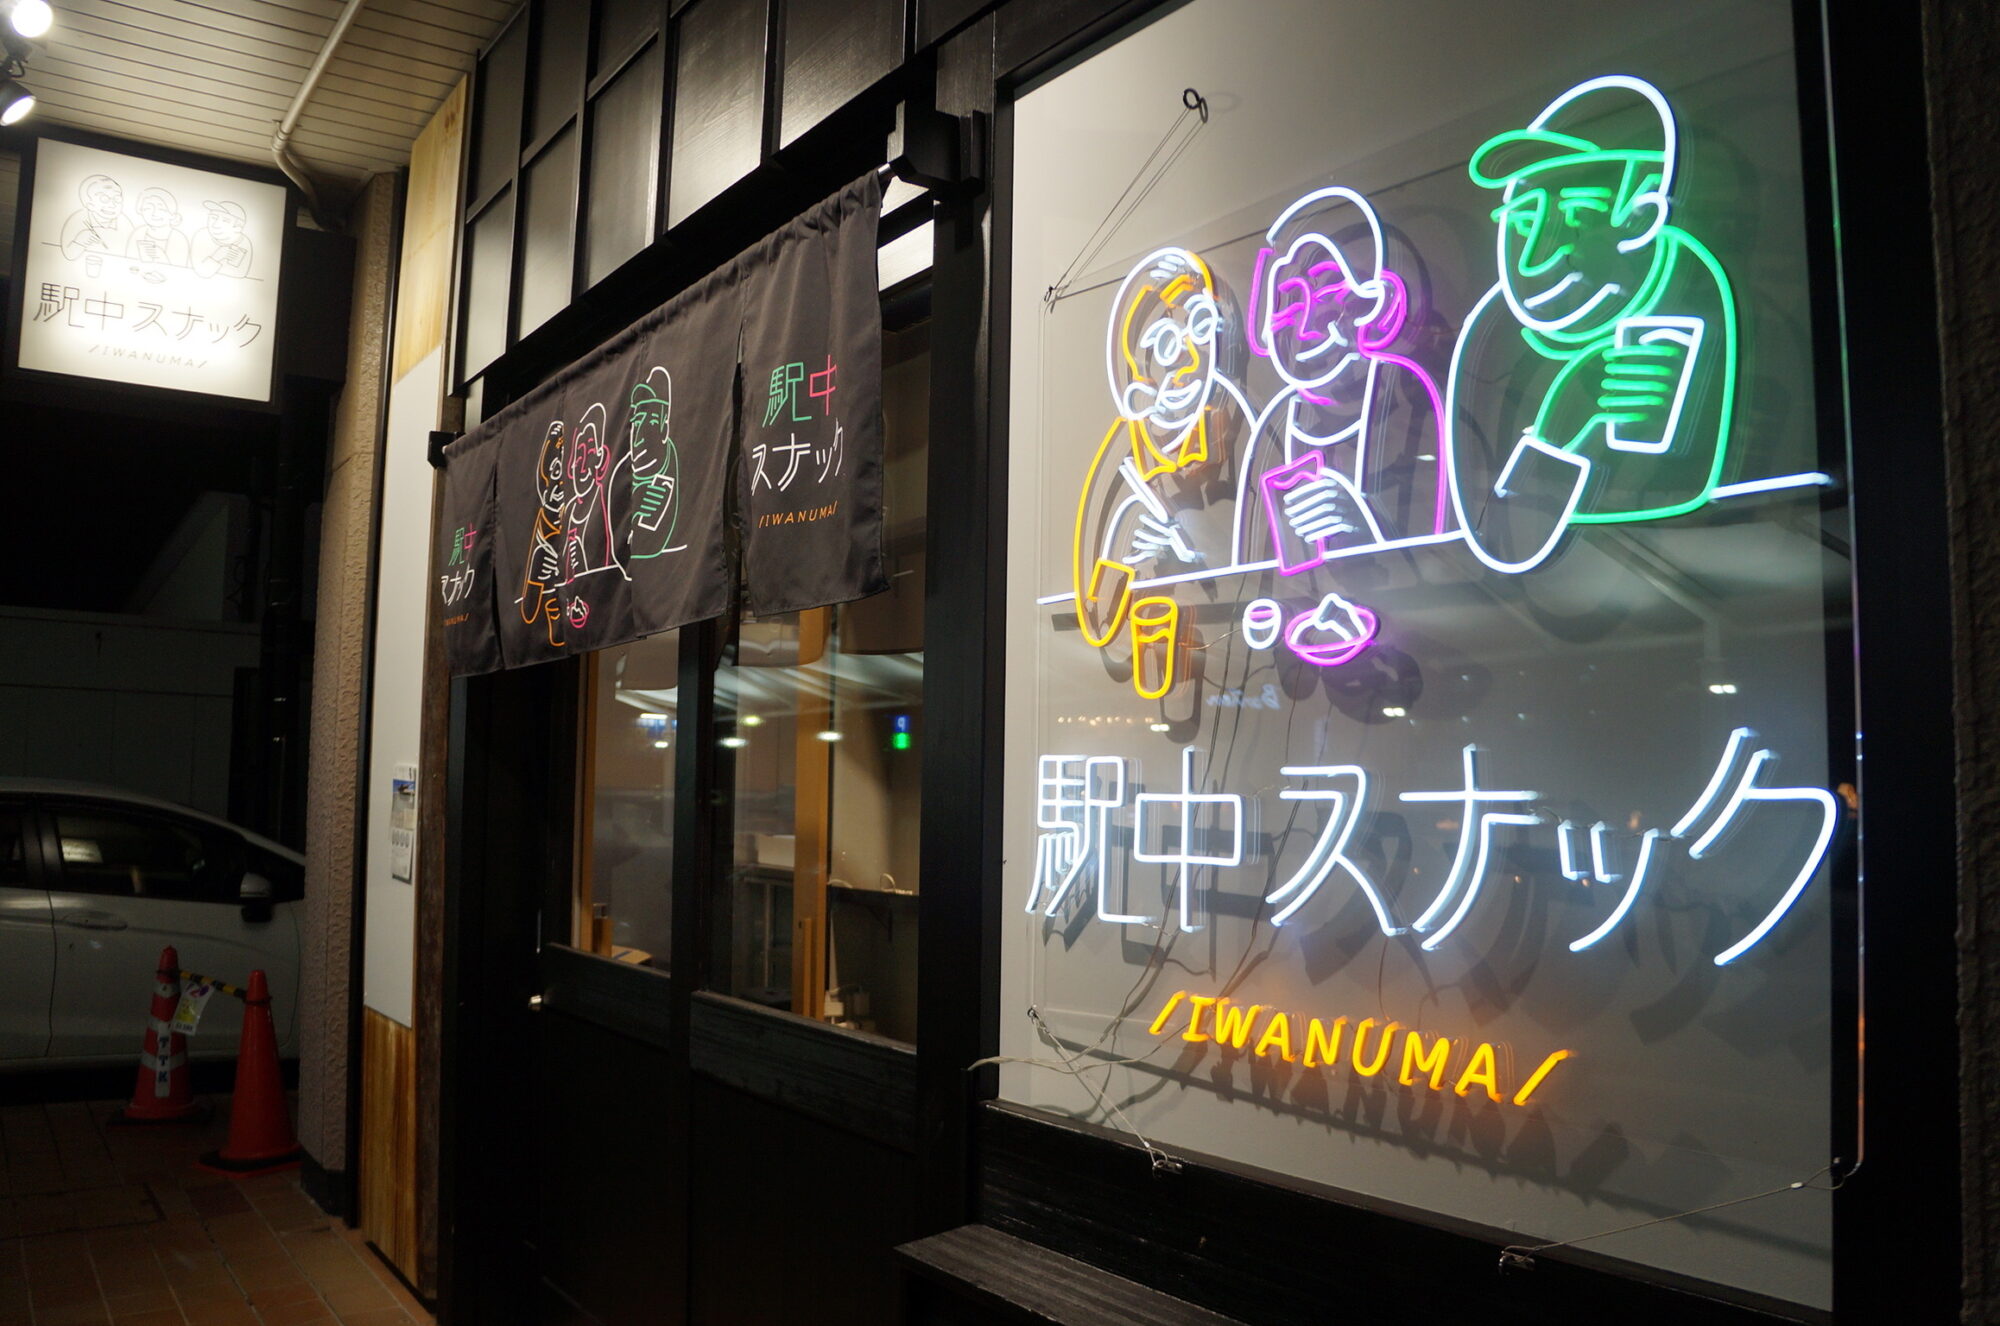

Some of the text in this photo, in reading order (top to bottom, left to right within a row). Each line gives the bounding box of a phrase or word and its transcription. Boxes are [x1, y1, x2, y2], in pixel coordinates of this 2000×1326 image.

[33, 282, 262, 348] 駅中スナック
[762, 353, 838, 428] 駅中
[751, 416, 844, 497] スナック
[1025, 726, 1838, 967] 駅中スナック
